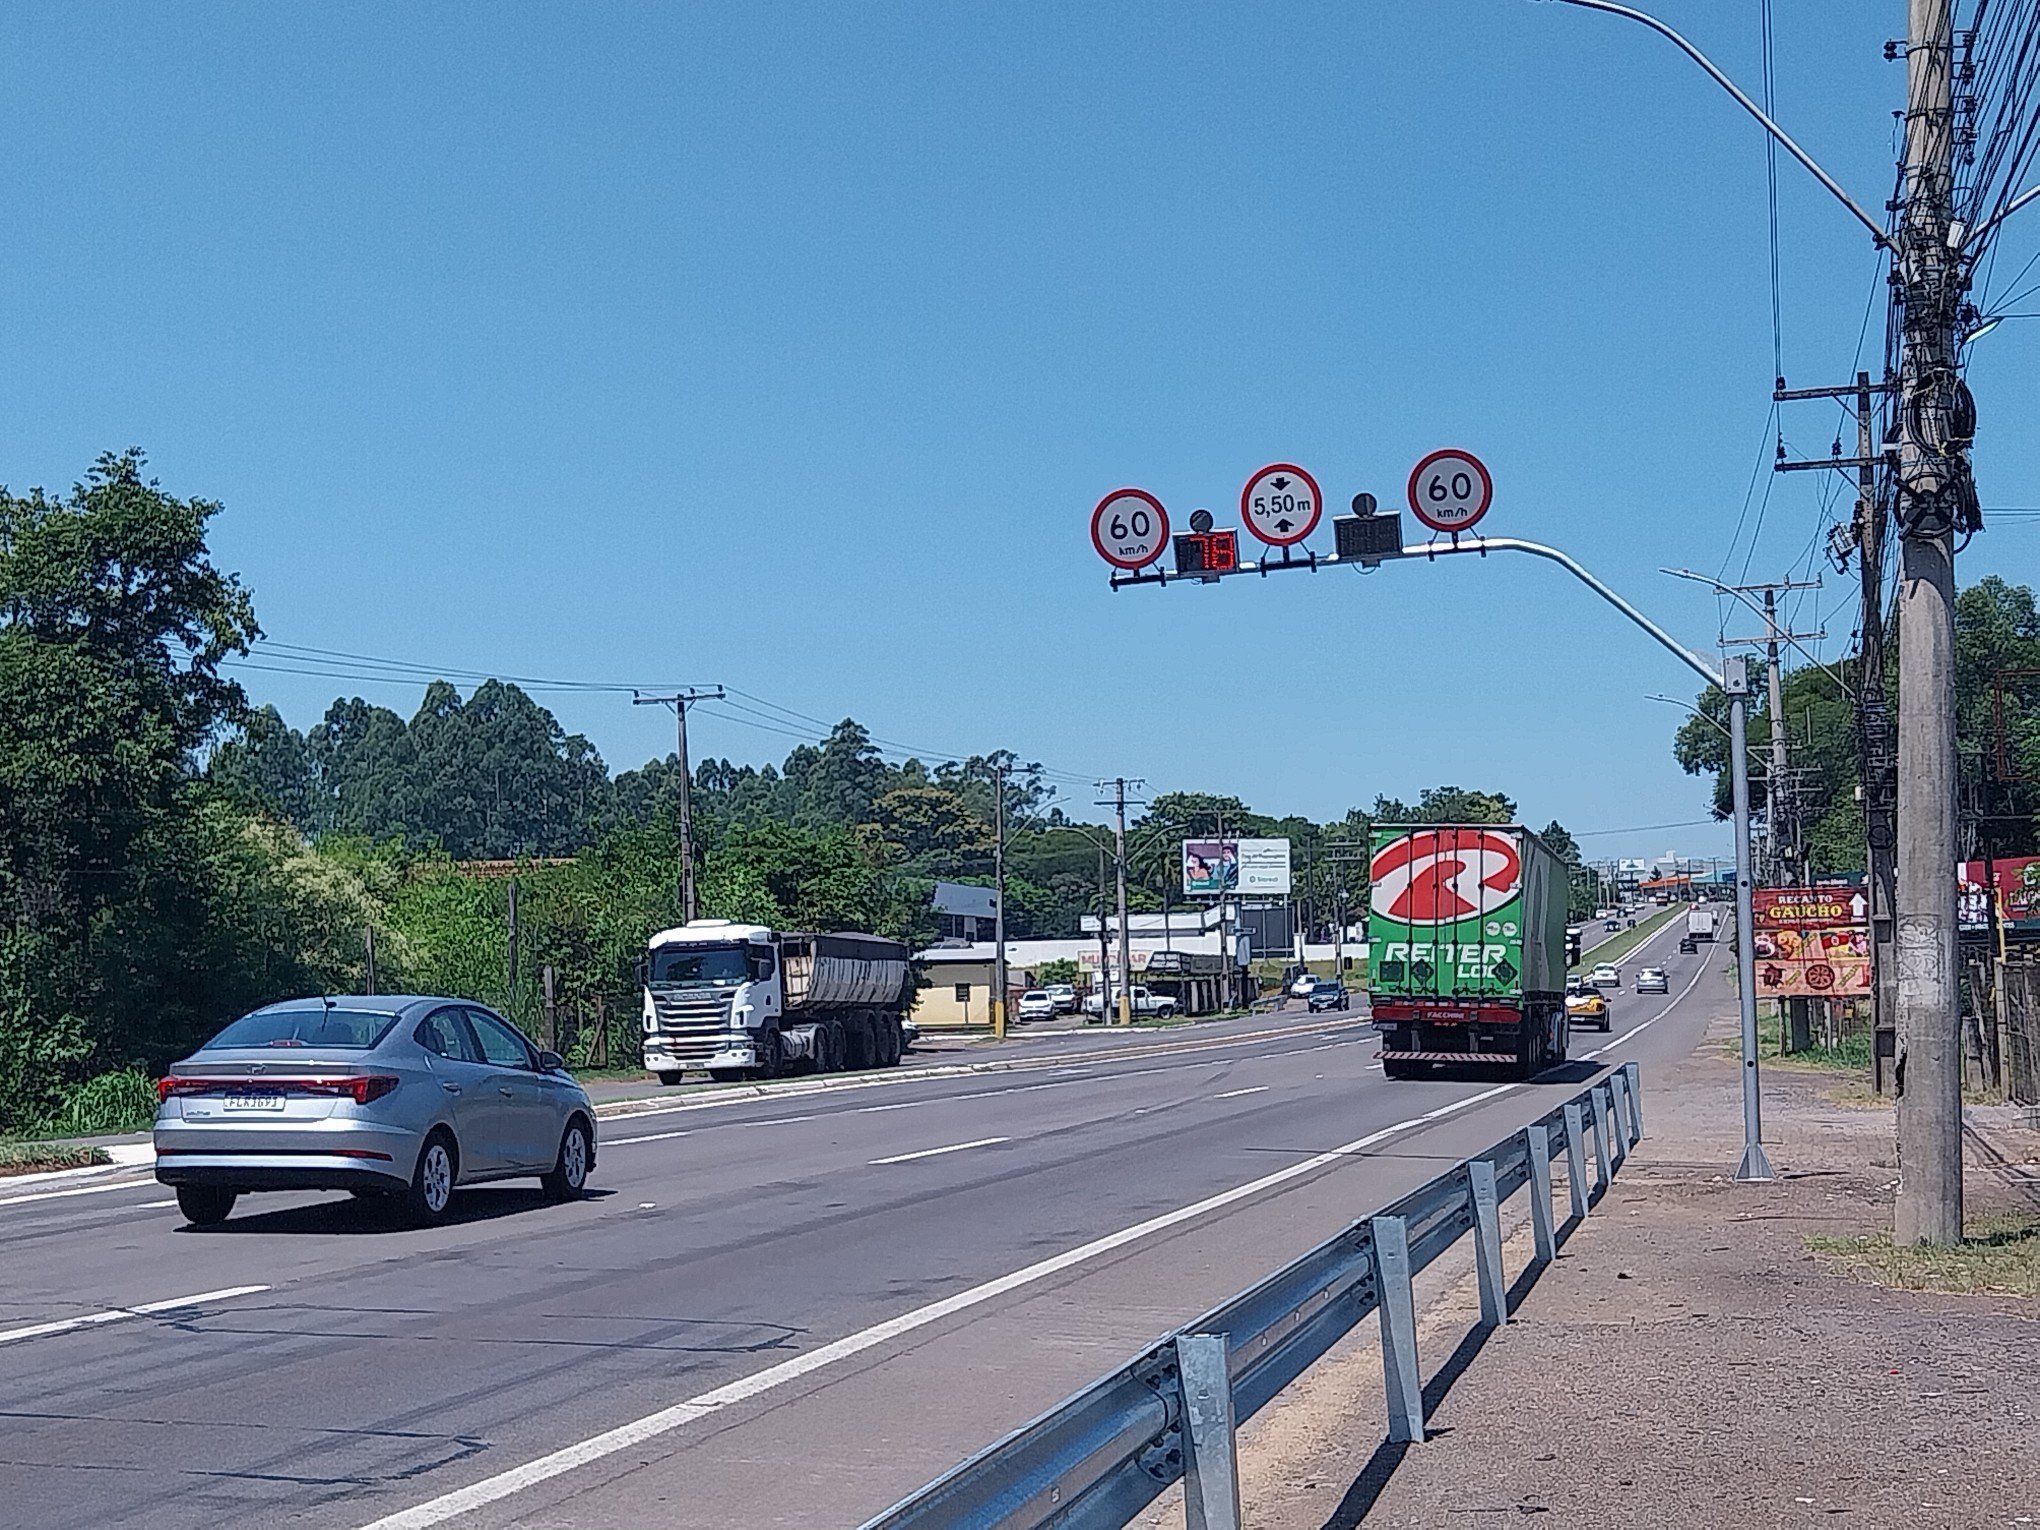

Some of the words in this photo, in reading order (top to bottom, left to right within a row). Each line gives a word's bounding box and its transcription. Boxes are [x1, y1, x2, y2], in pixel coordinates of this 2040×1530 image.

[1428, 472, 1472, 502] 60
[1436, 507, 1468, 519] km/h
[1110, 511, 1150, 540] 60
[1118, 544, 1149, 556] km/h
[1769, 905, 1843, 918] GAUCHO
[1385, 943, 1507, 963] REITER
